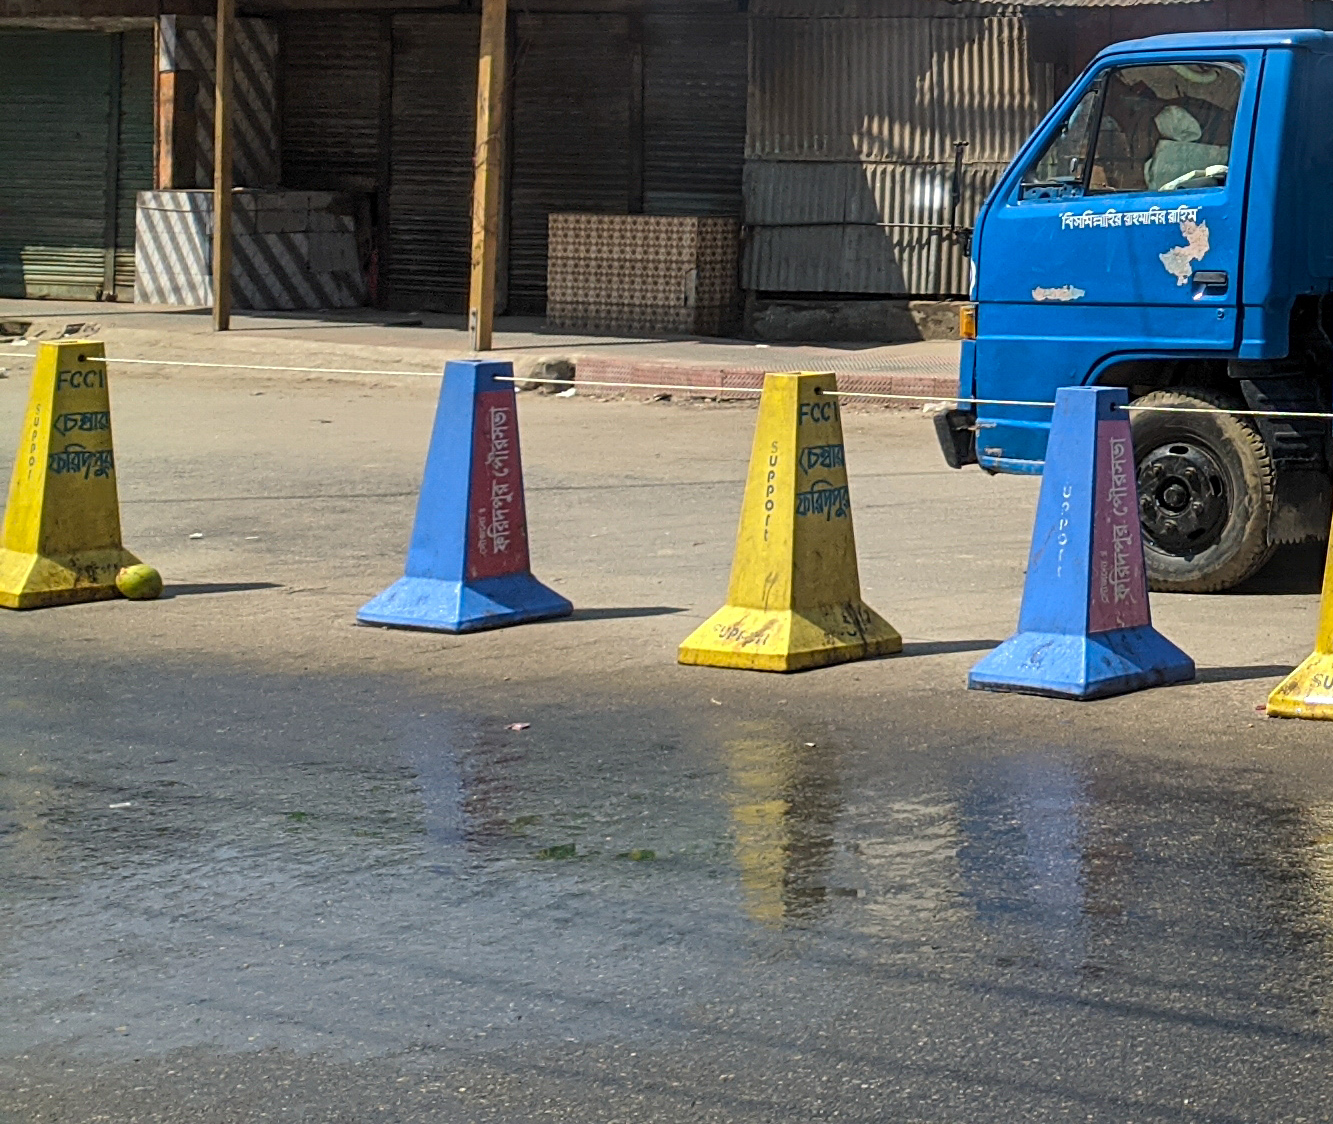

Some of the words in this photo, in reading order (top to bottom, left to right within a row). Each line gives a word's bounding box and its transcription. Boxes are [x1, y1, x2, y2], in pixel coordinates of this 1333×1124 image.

[1124, 205, 1166, 226] রাহমানির
[57, 369, 104, 392] FCCI
[53, 410, 111, 438] চেম্বার
[799, 402, 838, 426] FCCI
[800, 443, 845, 475] চেম্বার
[795, 479, 850, 522] ফরিদপুর
